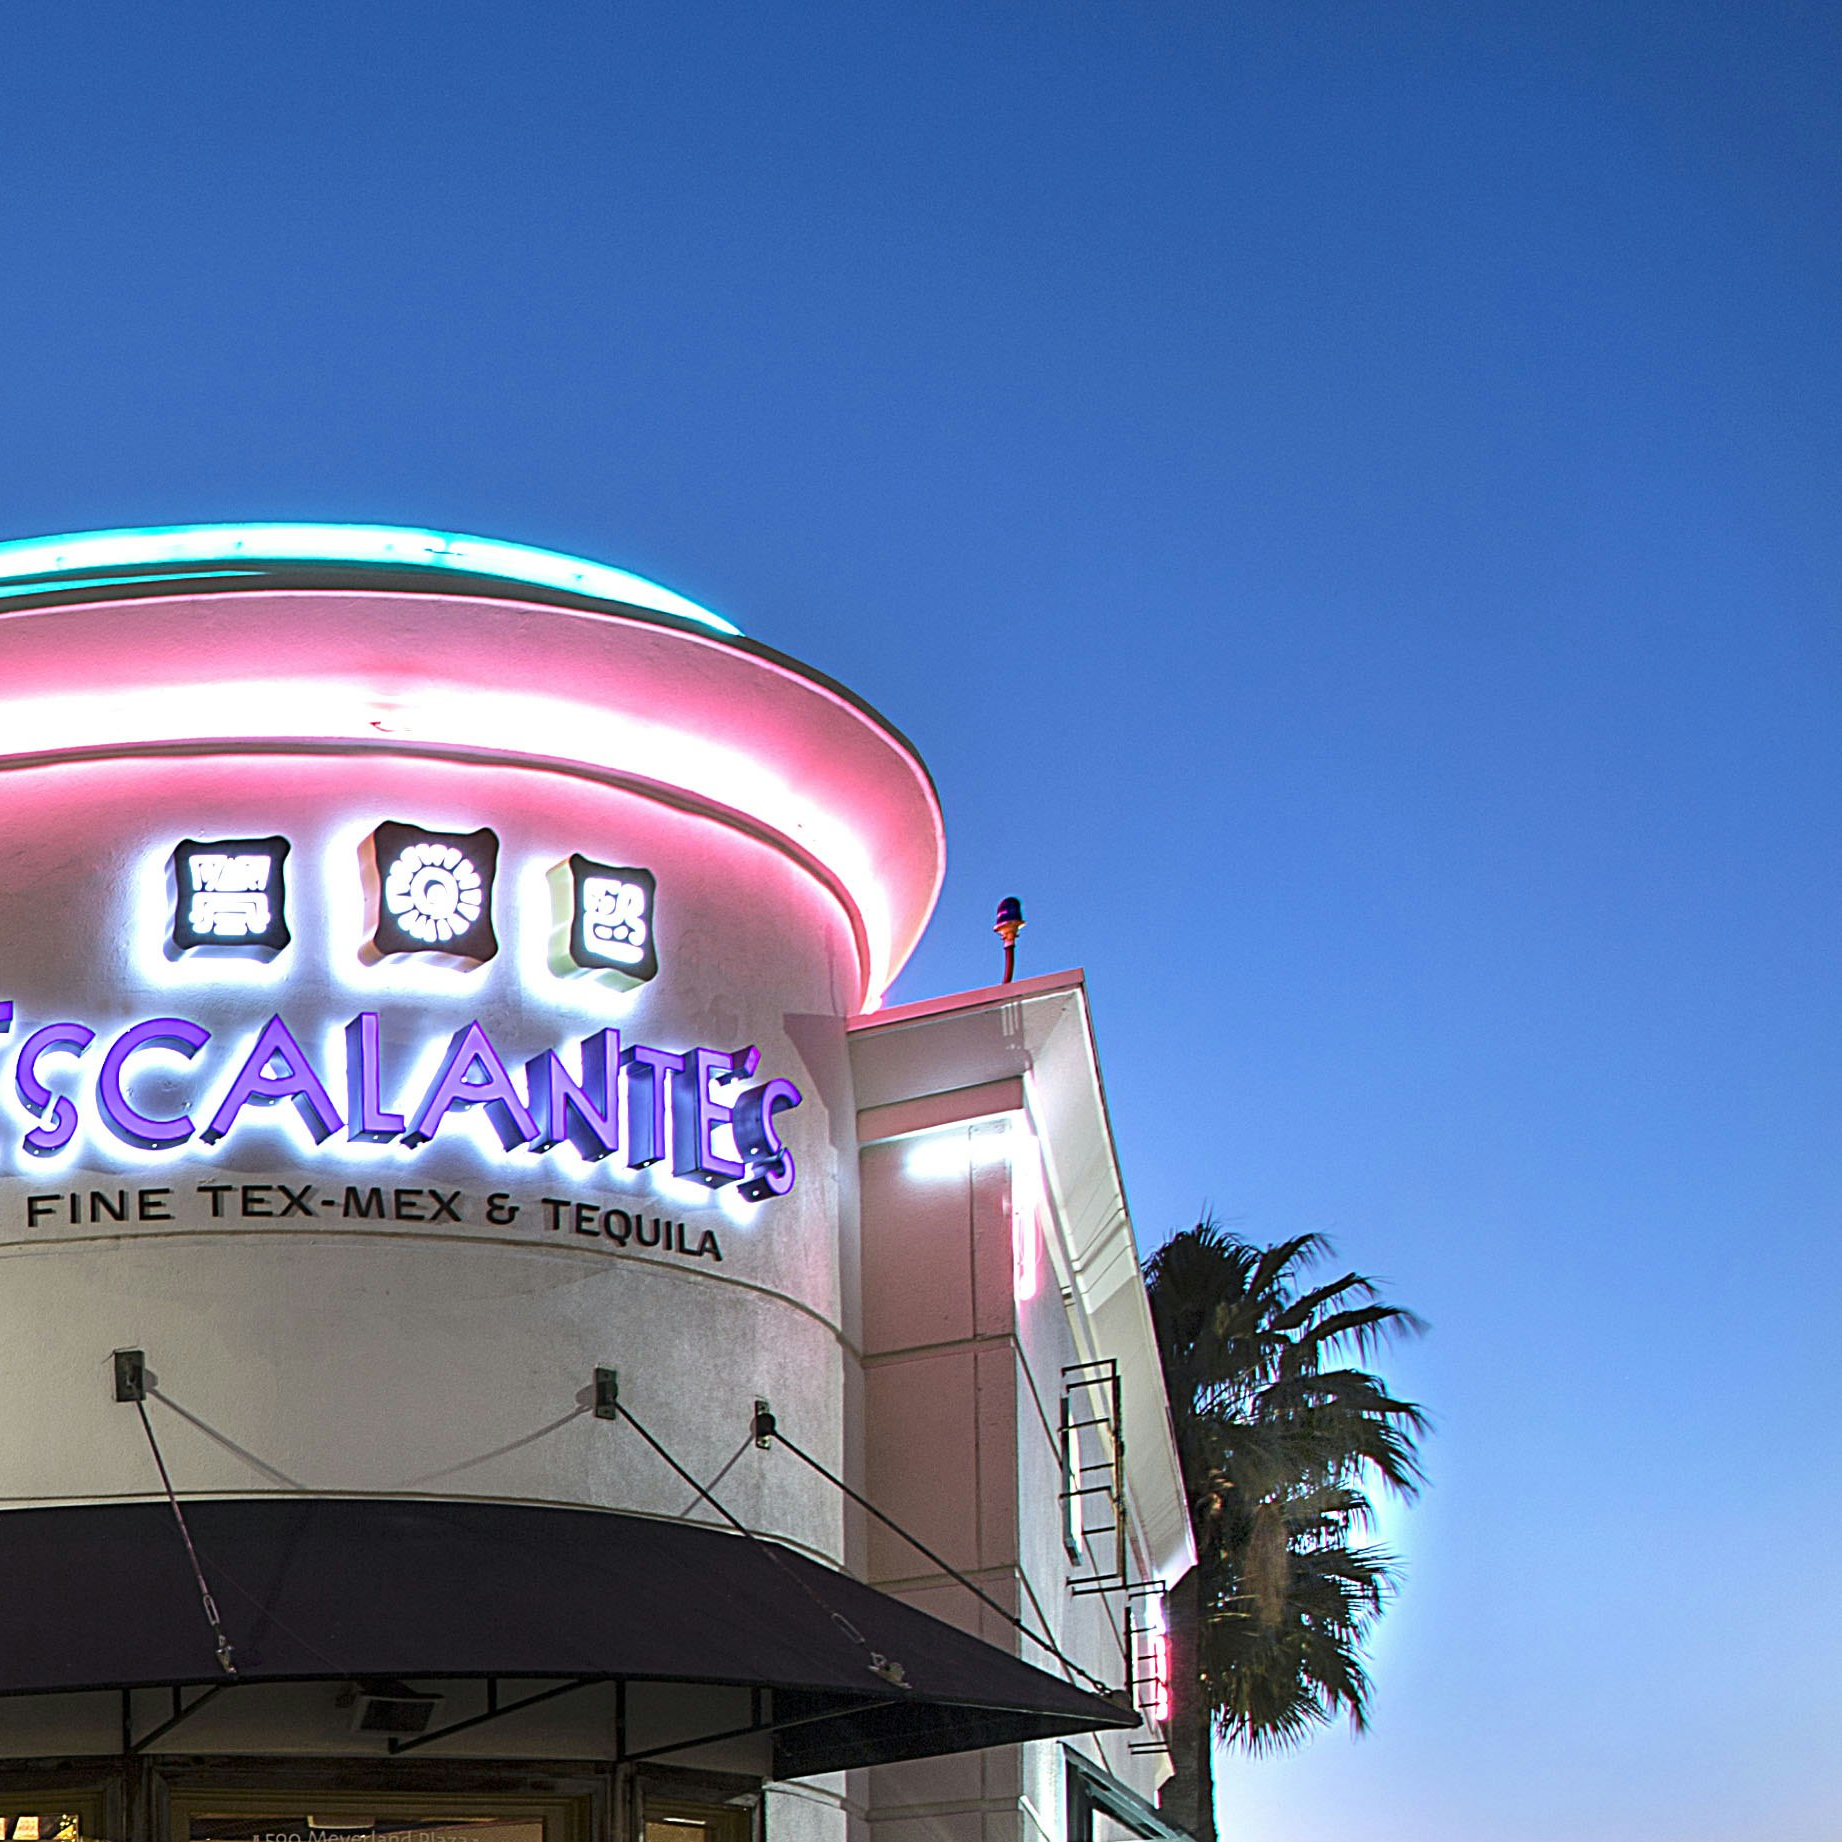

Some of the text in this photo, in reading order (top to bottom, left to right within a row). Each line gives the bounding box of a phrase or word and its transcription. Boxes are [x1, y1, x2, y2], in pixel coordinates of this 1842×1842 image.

[27, 1184, 724, 1262] FINE TEX-MEX & TEQUILA
